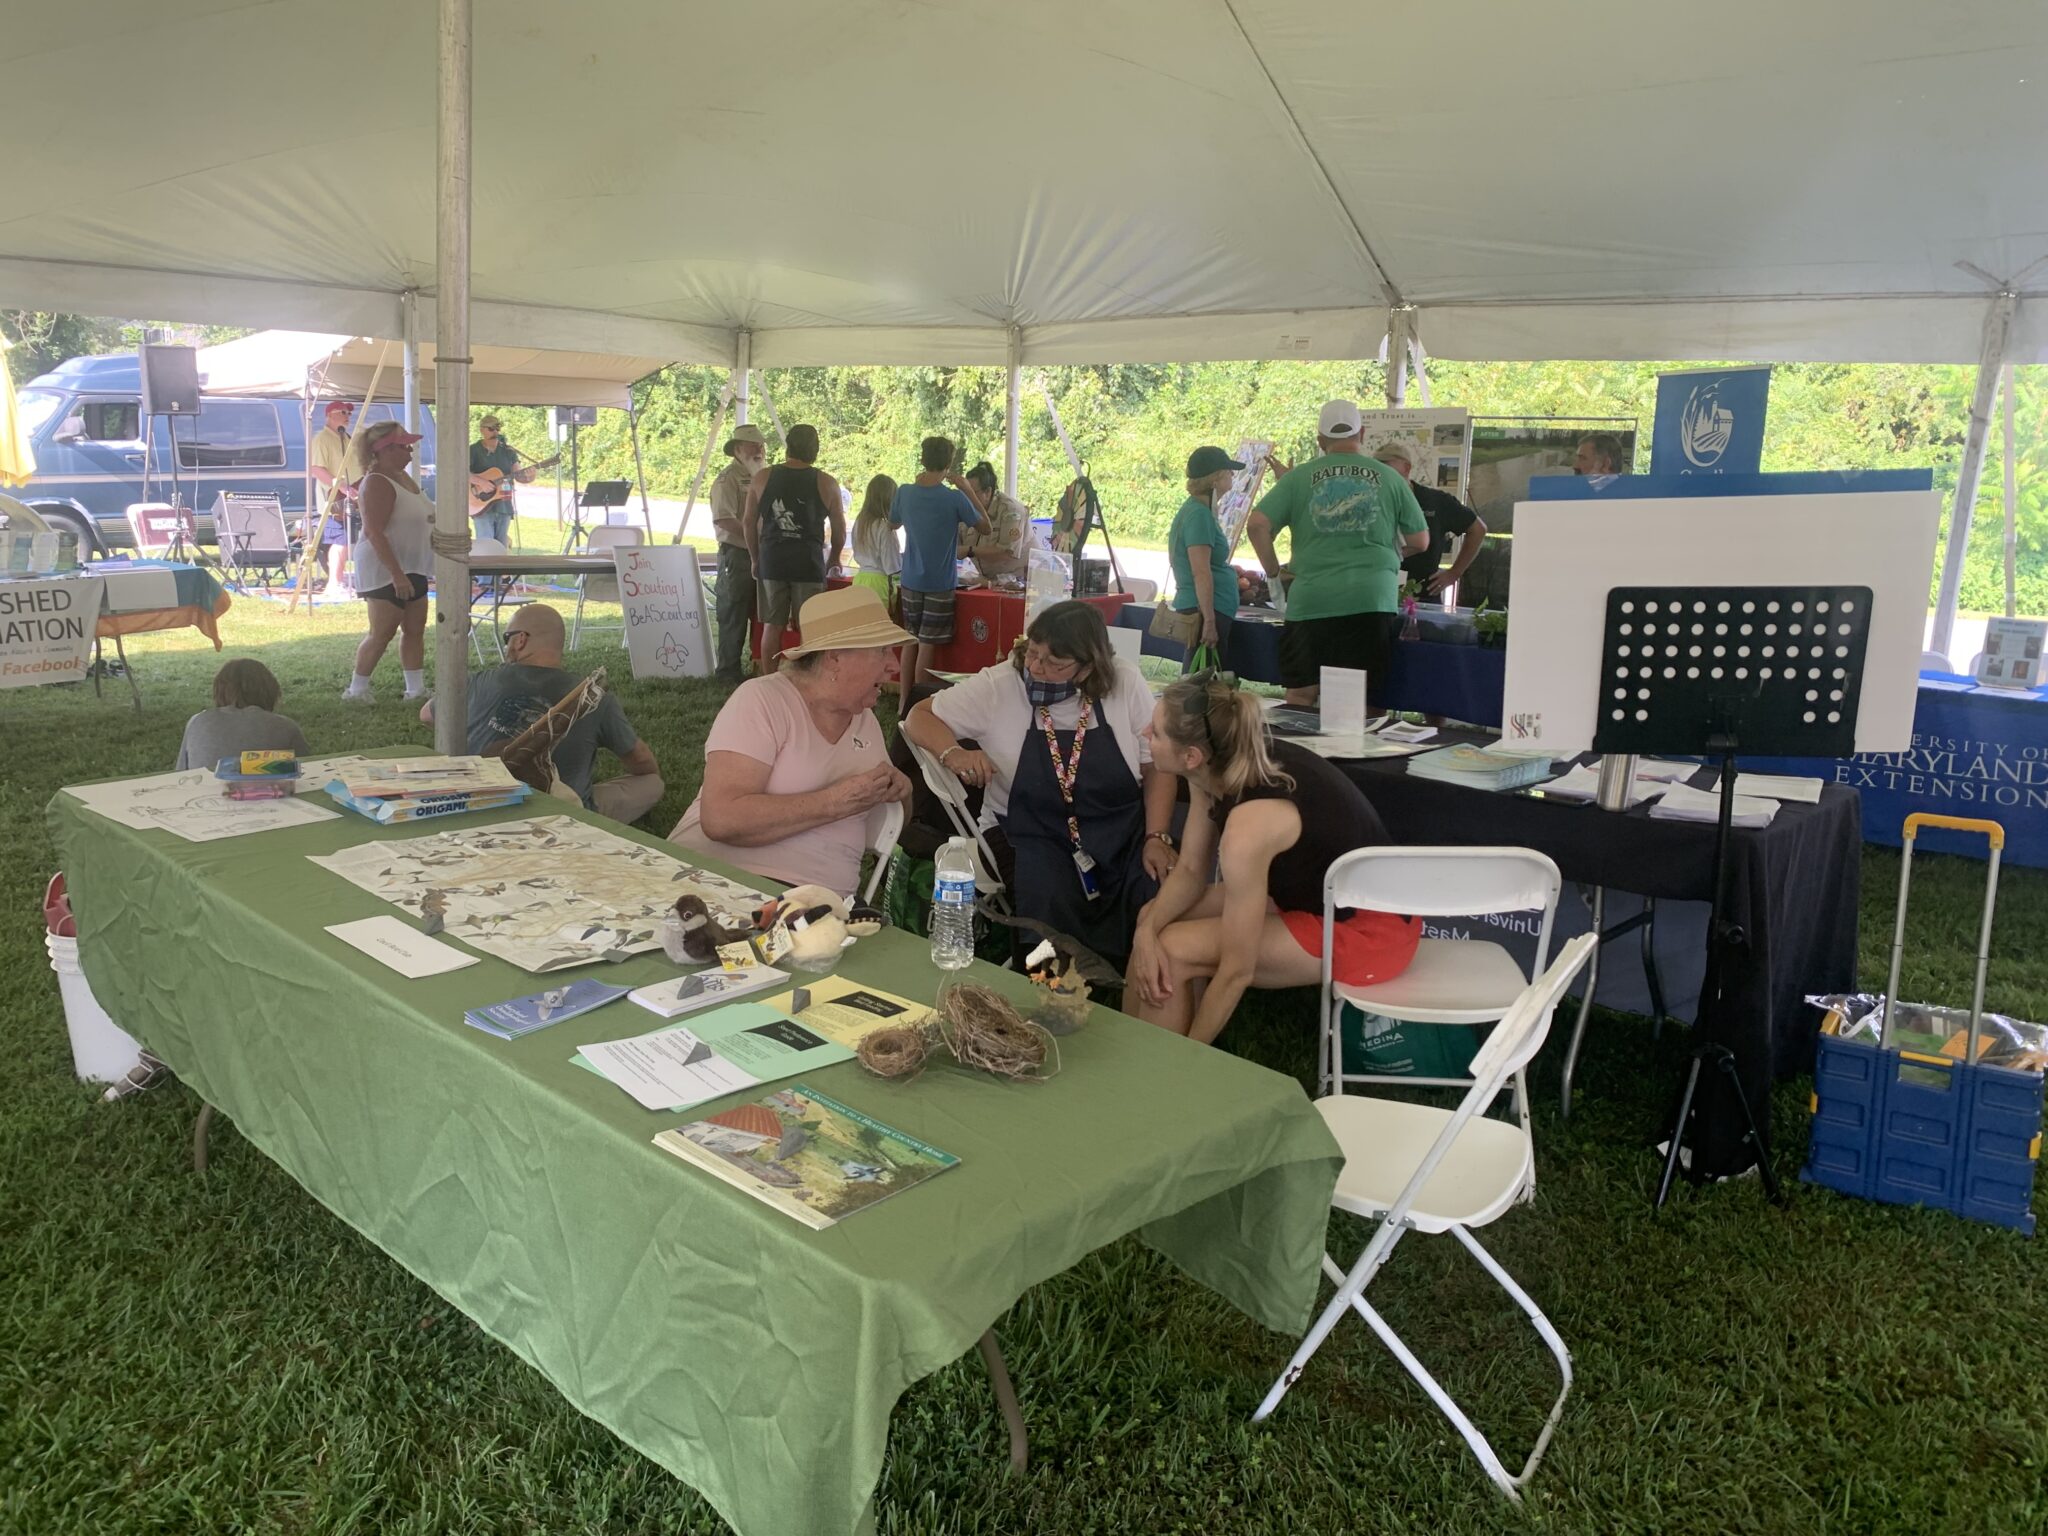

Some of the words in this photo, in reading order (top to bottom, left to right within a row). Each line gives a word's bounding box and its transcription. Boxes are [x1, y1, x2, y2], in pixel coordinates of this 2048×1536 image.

[1311, 465, 1346, 487] BAIT
[1350, 465, 1382, 486] BOX
[628, 552, 655, 571] Join
[1, 589, 72, 615] SHED
[1832, 764, 2048, 809] EXTENSION
[416, 801, 467, 816] ORIGAMI
